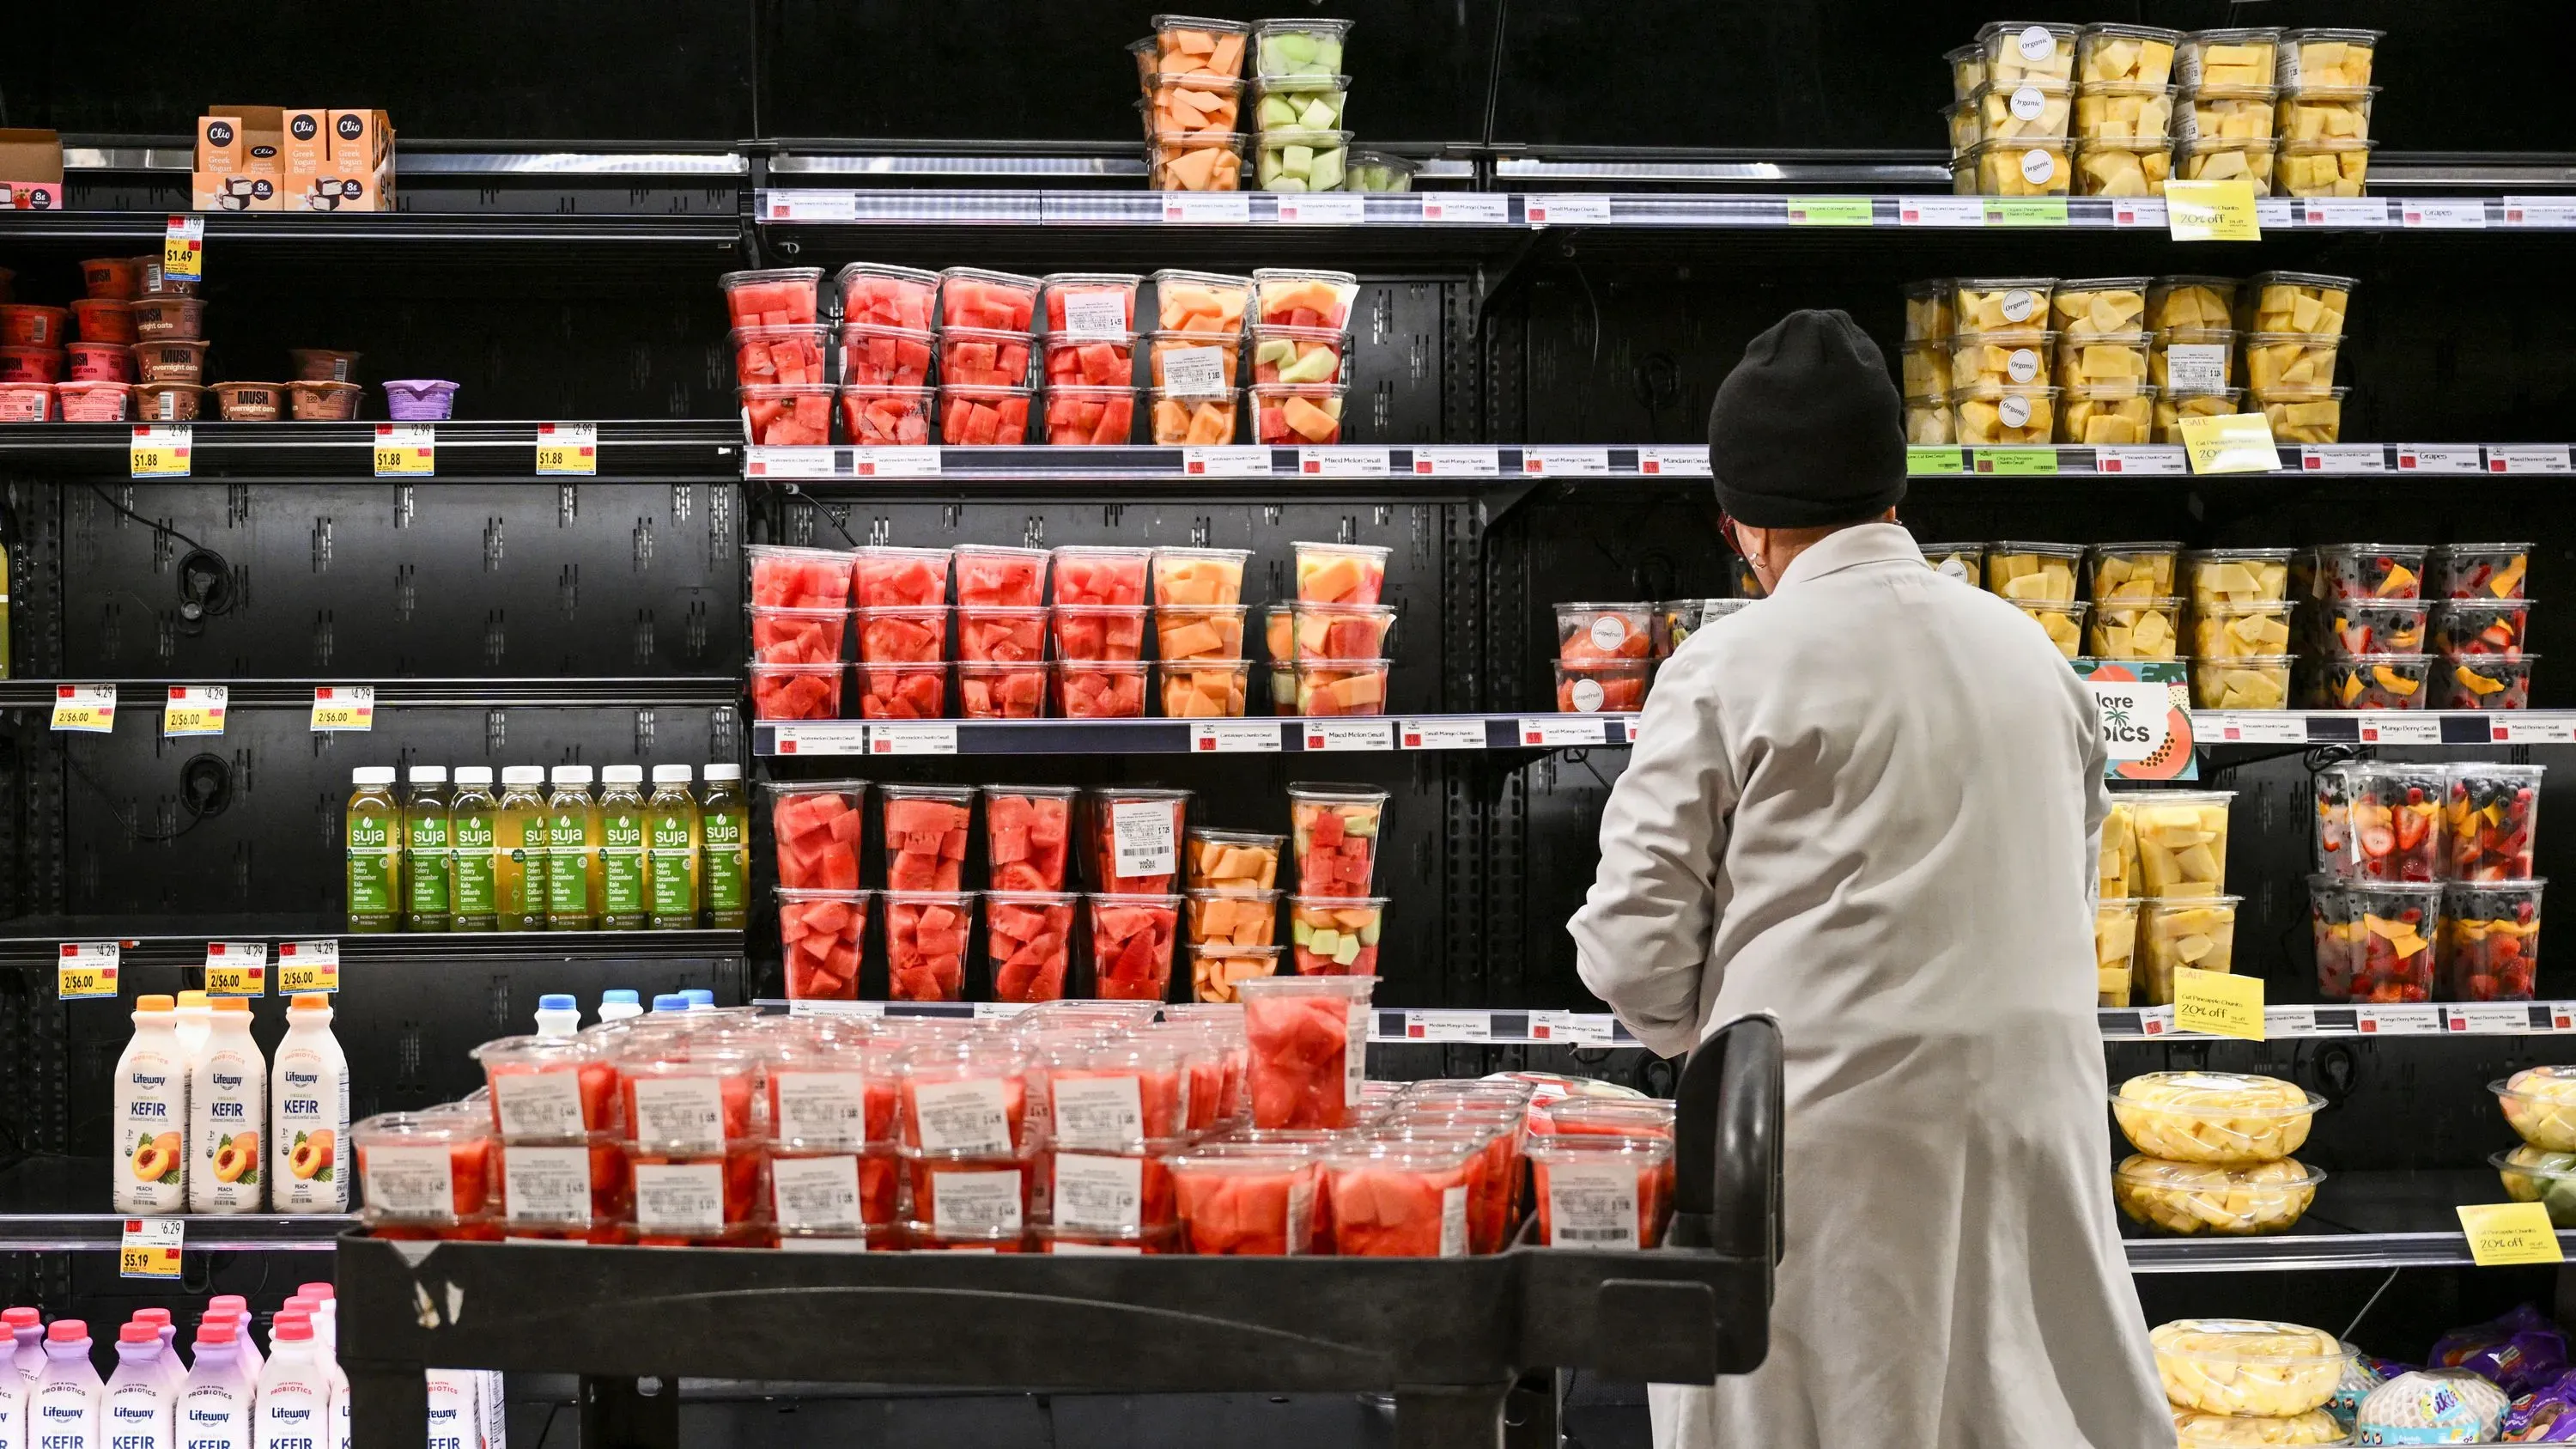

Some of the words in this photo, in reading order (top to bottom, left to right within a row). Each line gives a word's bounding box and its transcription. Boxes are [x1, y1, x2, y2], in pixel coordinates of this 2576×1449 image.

[2021, 37, 2048, 50] Organic
[294, 121, 314, 132] Clio
[339, 120, 360, 132] Clio
[210, 127, 230, 139] Clio
[209, 163, 233, 173] Yogurt
[294, 158, 317, 167] Yogurt
[339, 157, 362, 167] Yogurt
[2025, 160, 2050, 174] Organic
[258, 182, 268, 192] 8g
[347, 182, 357, 192] 8g
[35, 192, 46, 201] 8g
[2207, 213, 2226, 224] off
[2424, 208, 2452, 216] Grapes
[167, 249, 193, 262] $1.49
[2005, 297, 2030, 313] Organic
[161, 349, 191, 363] MUSH
[152, 363, 185, 372] overnight
[2010, 360, 2034, 370] Organic
[237, 390, 269, 405] MUSH
[2002, 401, 2027, 418] Organic
[573, 423, 592, 435] $2.99
[2184, 418, 2209, 427] SALE
[411, 423, 430, 436] $2.99
[134, 454, 158, 467] $1.88
[377, 453, 401, 466] $1.88
[538, 452, 562, 465] $1.88
[2419, 452, 2447, 460] Grapes
[1595, 629, 1622, 639] Grapefruit
[94, 686, 113, 699] $4.29
[204, 687, 224, 700] $4.29
[351, 687, 371, 700] $4.29
[1574, 691, 1601, 701] Grapefruit
[58, 712, 89, 722] 2/$6.00
[171, 713, 200, 726] 2/$6.00
[319, 712, 348, 722] 2/$6.00
[353, 829, 385, 845] suja
[414, 830, 447, 846] suja
[459, 830, 492, 846] suja
[551, 829, 583, 844] suja
[608, 829, 641, 844] suja
[655, 831, 688, 846] suja
[706, 826, 738, 842] suja
[96, 944, 116, 957] $4.29
[243, 945, 264, 958] $4.29
[314, 942, 334, 955] $4.29
[64, 975, 94, 989] 2/$6.00
[210, 974, 240, 988] 2/$6.00
[283, 971, 313, 985] 2/$6.00
[2191, 995, 2221, 1005] Pineapple
[2181, 1002, 2207, 1016] 20%
[2208, 1008, 2228, 1019] off
[132, 1072, 166, 1087] Lifeway
[213, 1073, 242, 1087] Lifeway
[285, 1070, 319, 1084] Lifeway
[131, 1101, 167, 1117] KEFIR
[212, 1102, 243, 1117] KEFIR
[284, 1099, 319, 1114] KEFIR
[161, 1222, 180, 1235] $6.29
[2480, 1239, 2506, 1250] 20%
[2506, 1237, 2524, 1247] off
[125, 1252, 149, 1267] $5.19
[42, 1385, 87, 1397] PROBIOTICS
[113, 1385, 157, 1397] PROBIOTICS
[188, 1390, 233, 1401] PROBIOTICS
[270, 1385, 313, 1395] PROBIOTICS
[43, 1405, 83, 1419] Lifeway
[114, 1406, 155, 1420] Lifeway
[189, 1409, 230, 1423] Lifeway
[271, 1405, 310, 1420] Lifeway
[42, 1435, 84, 1449] KEFIR
[112, 1436, 155, 1449] KEFIR
[270, 1438, 313, 1449] KEFIR
